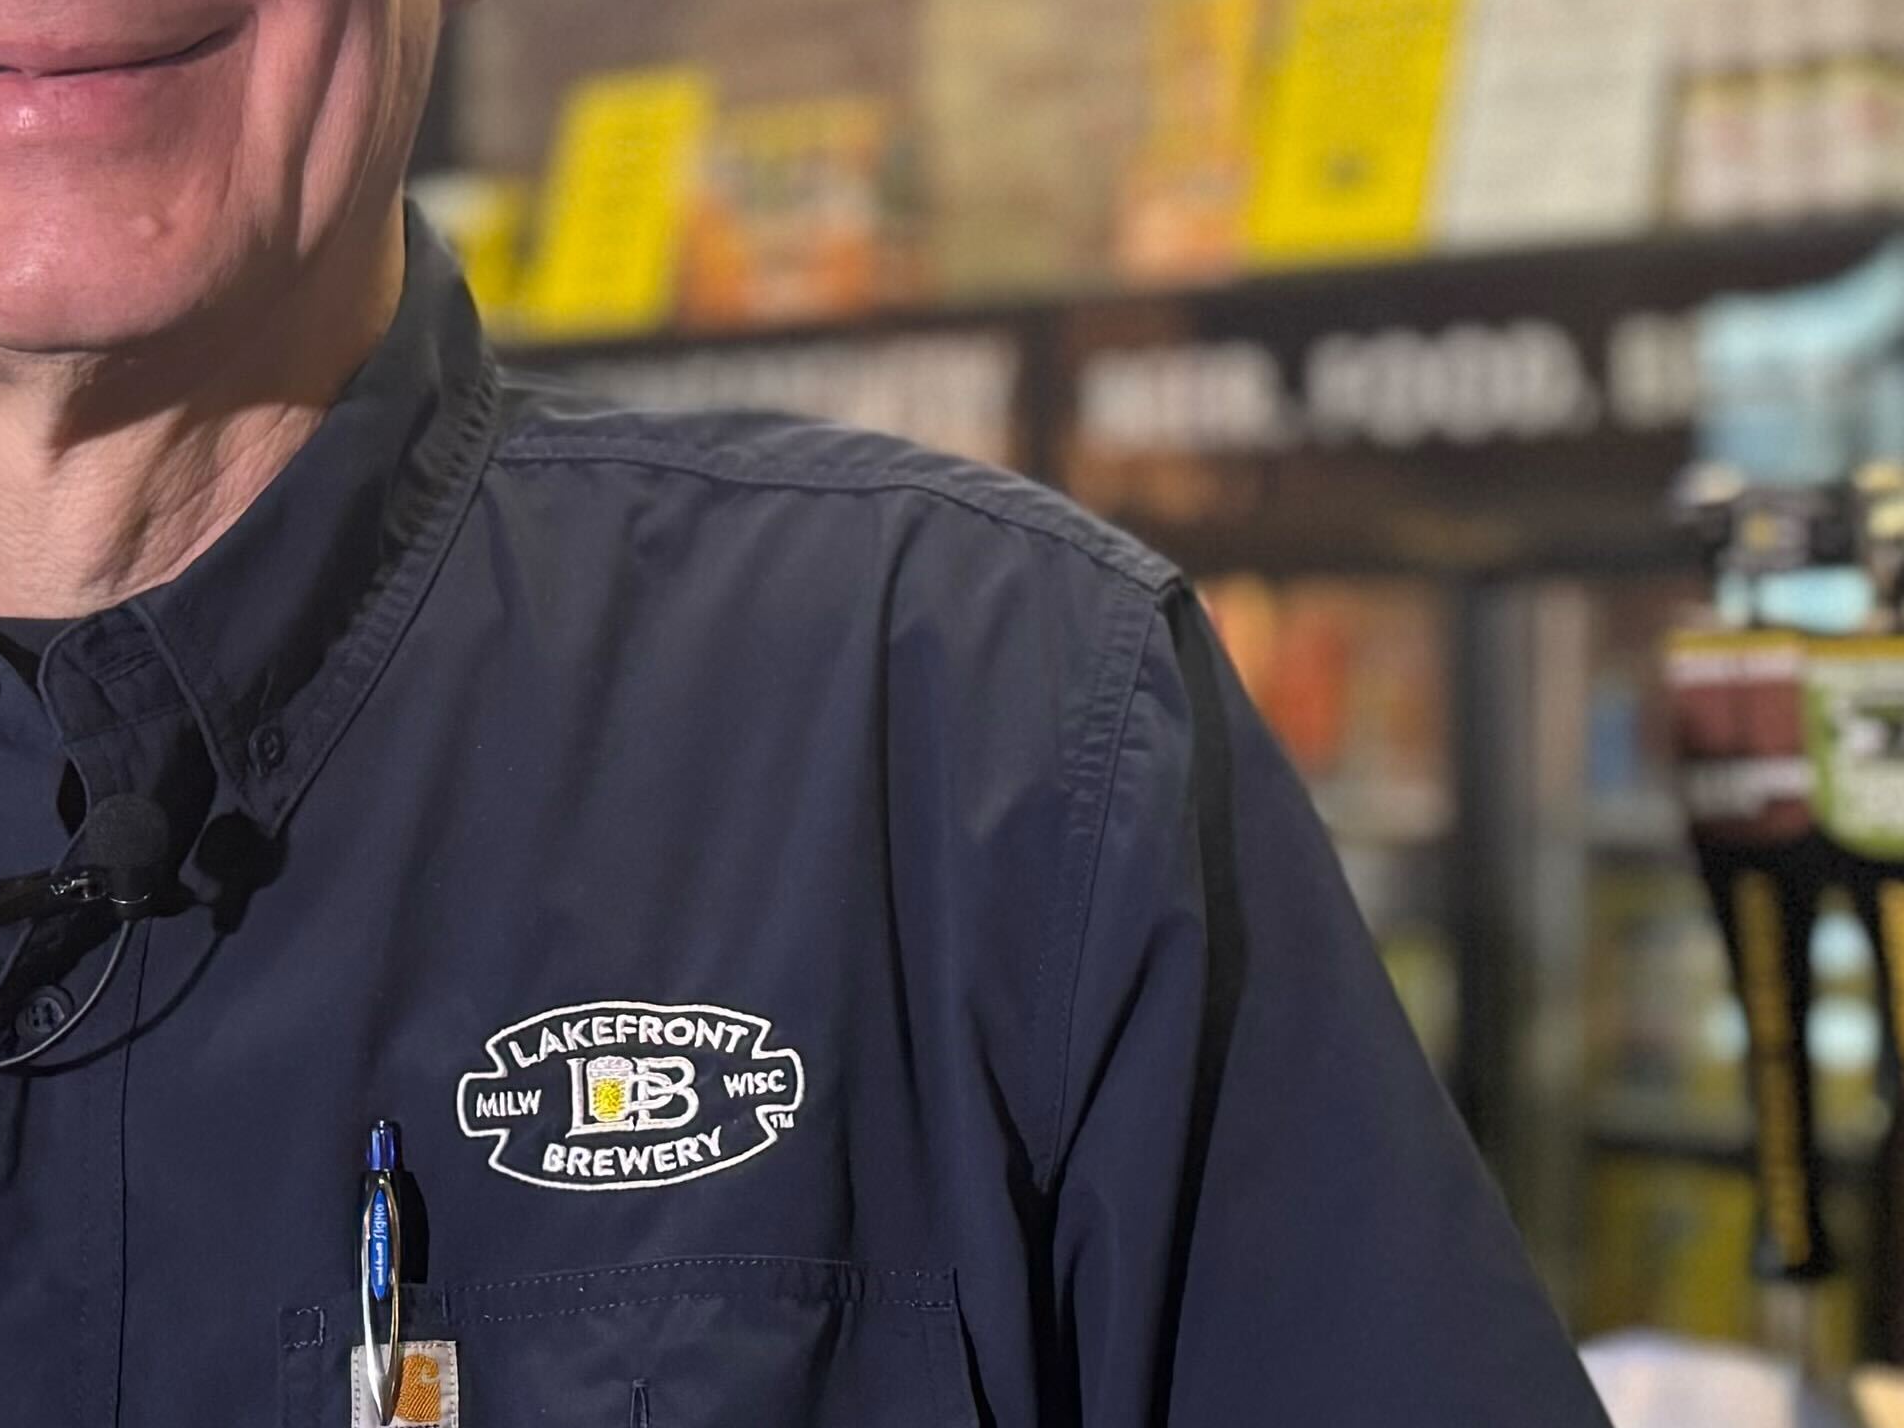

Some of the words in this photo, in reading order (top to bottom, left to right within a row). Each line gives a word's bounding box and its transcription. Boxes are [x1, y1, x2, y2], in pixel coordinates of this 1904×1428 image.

[508, 1015, 749, 1068] LAKEFRONT
[475, 1089, 542, 1118] MILW
[723, 1069, 787, 1098] WISC
[542, 1126, 723, 1176] BREWERY
